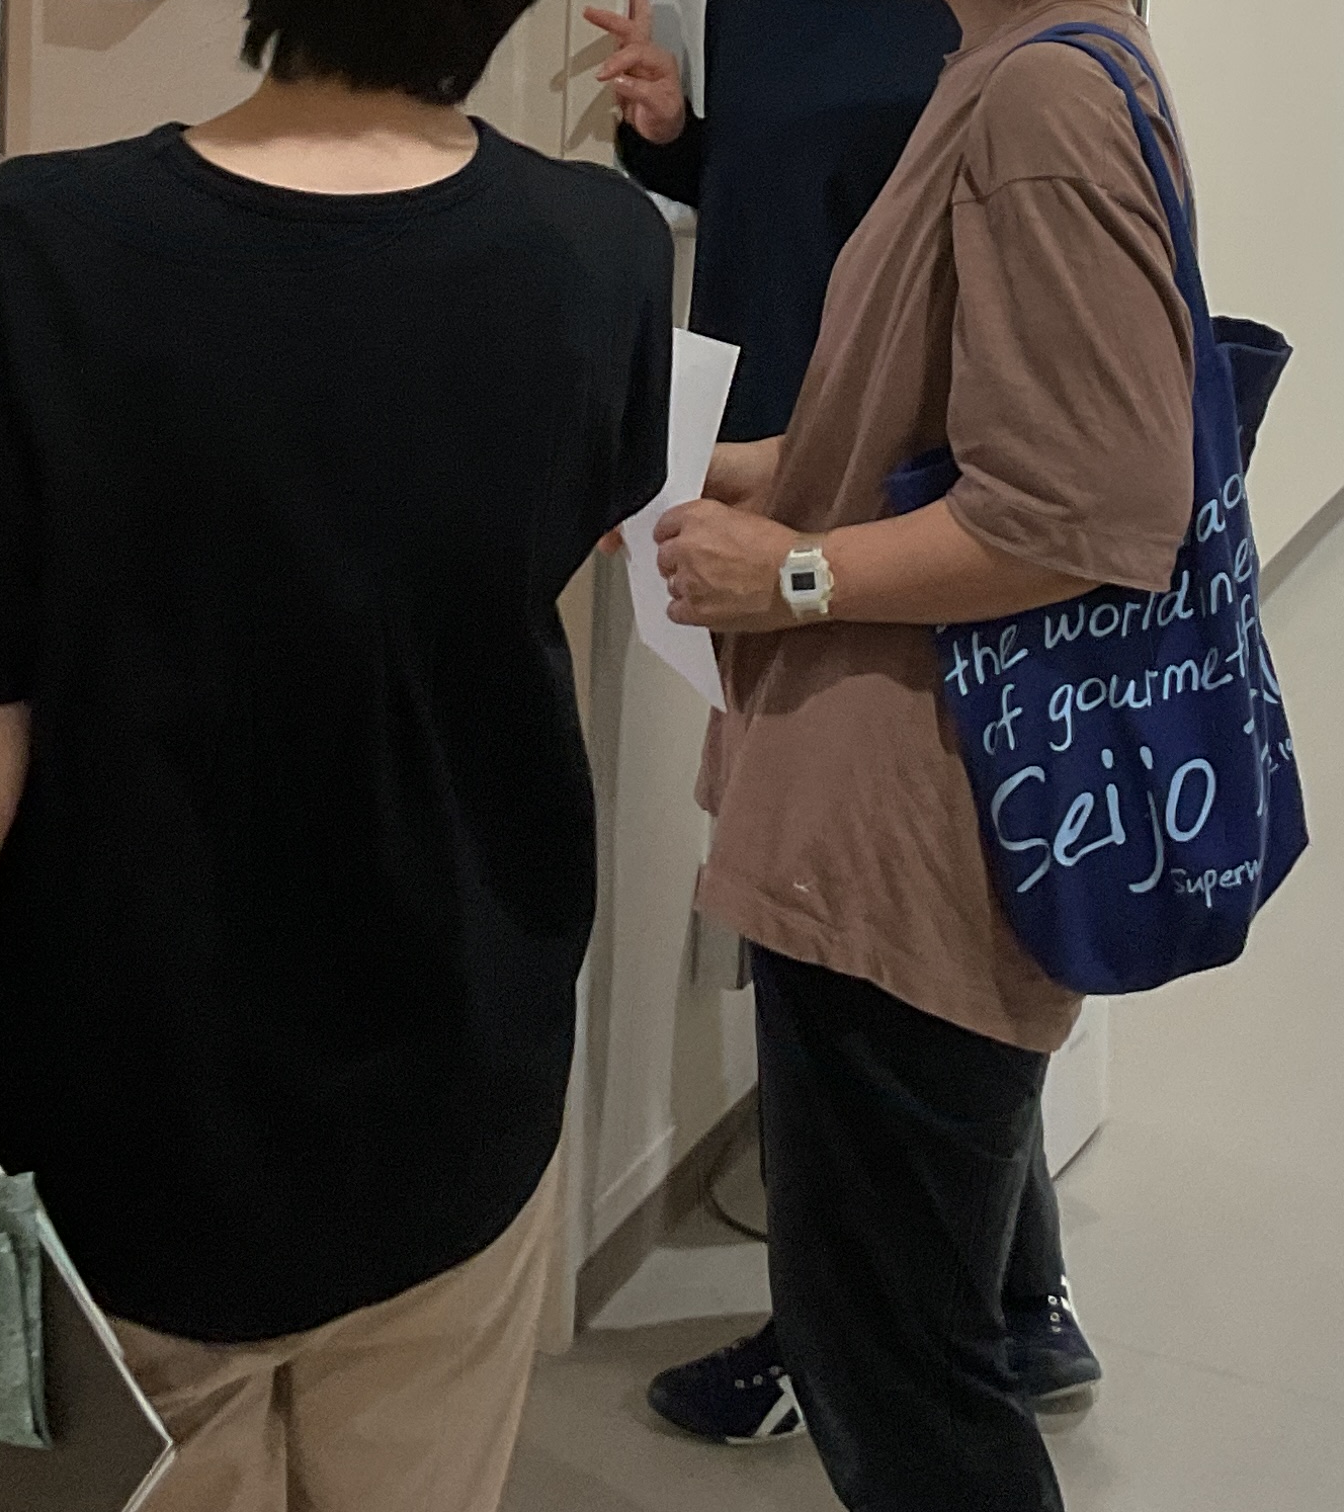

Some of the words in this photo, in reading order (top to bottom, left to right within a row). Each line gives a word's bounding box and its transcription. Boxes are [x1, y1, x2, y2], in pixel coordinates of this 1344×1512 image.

[944, 624, 1029, 697] the
[1044, 569, 1195, 649] world
[982, 682, 1024, 756] of
[990, 744, 1217, 894] Seijo
